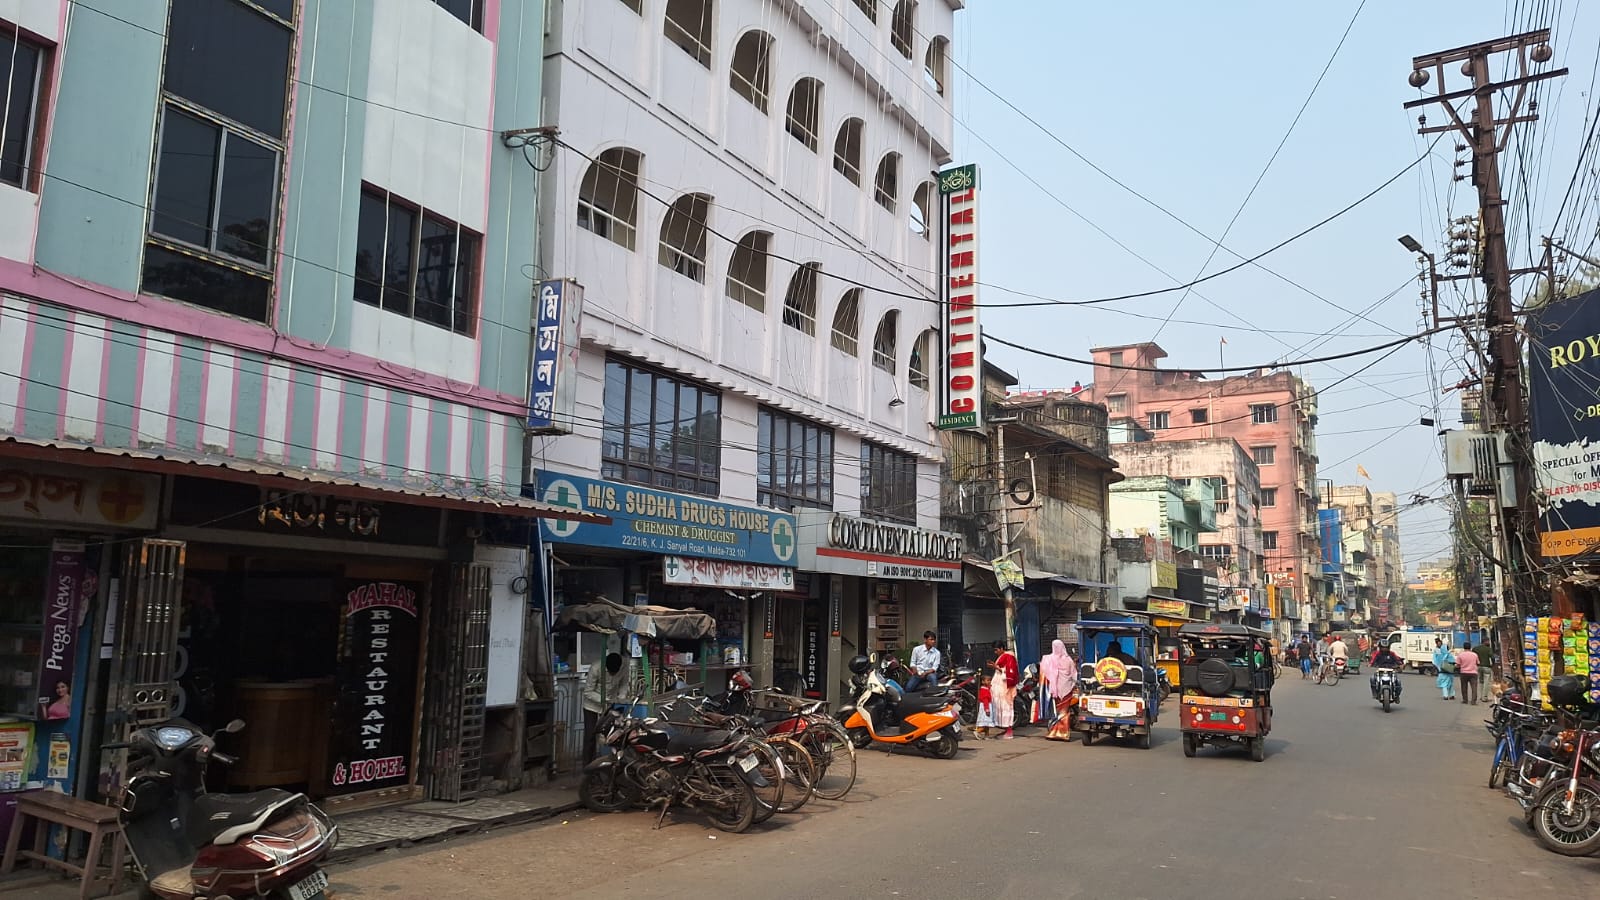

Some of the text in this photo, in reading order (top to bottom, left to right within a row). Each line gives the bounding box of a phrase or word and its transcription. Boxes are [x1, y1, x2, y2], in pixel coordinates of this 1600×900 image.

[950, 187, 974, 413] CONTINENTAL
[1549, 333, 1600, 369] ROY
[940, 415, 975, 426] RESIDENCY
[1542, 455, 1581, 471] SPECIAL
[1574, 471, 1586, 482] for
[587, 484, 769, 534] M/S. SUDHA DRUGS HOUSE
[634, 519, 736, 544] CHEMIST & DRUGGIST
[827, 515, 963, 561] CONTINENTAL LODGE
[1565, 539, 1576, 547] OF
[51, 575, 72, 620] News
[346, 582, 417, 617] MAHAL
[46, 624, 71, 670] Prega
[808, 631, 816, 688] RESTAURANT
[361, 609, 392, 750] RESTAURANT
[333, 756, 406, 785] & HOTEL
